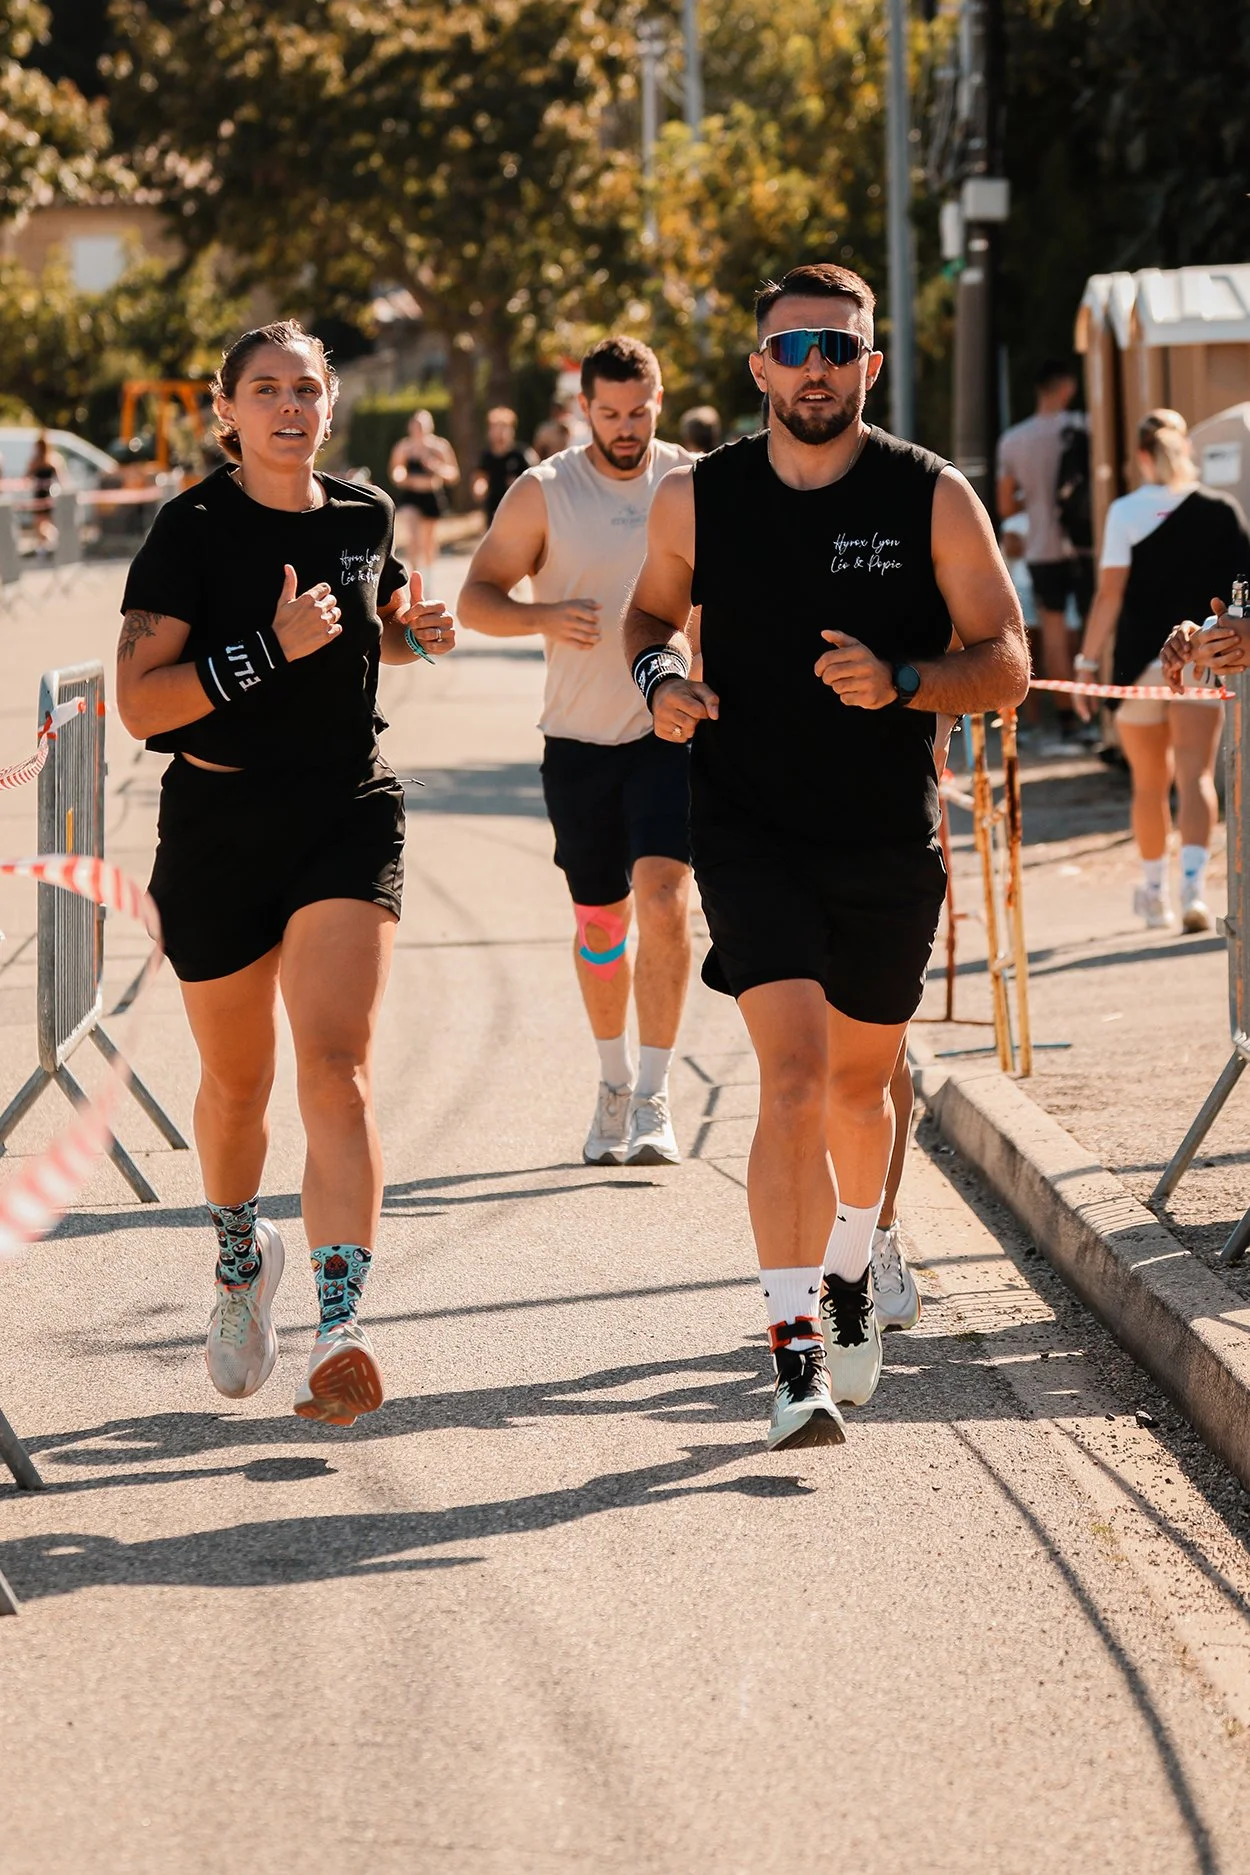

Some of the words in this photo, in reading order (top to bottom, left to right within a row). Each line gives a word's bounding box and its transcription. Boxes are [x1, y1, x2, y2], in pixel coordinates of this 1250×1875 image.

[833, 532, 868, 555] Hyrox
[872, 532, 900, 554] Lyon
[831, 556, 850, 573] Léo
[853, 556, 864, 569] &
[225, 643, 262, 690] ELIT
